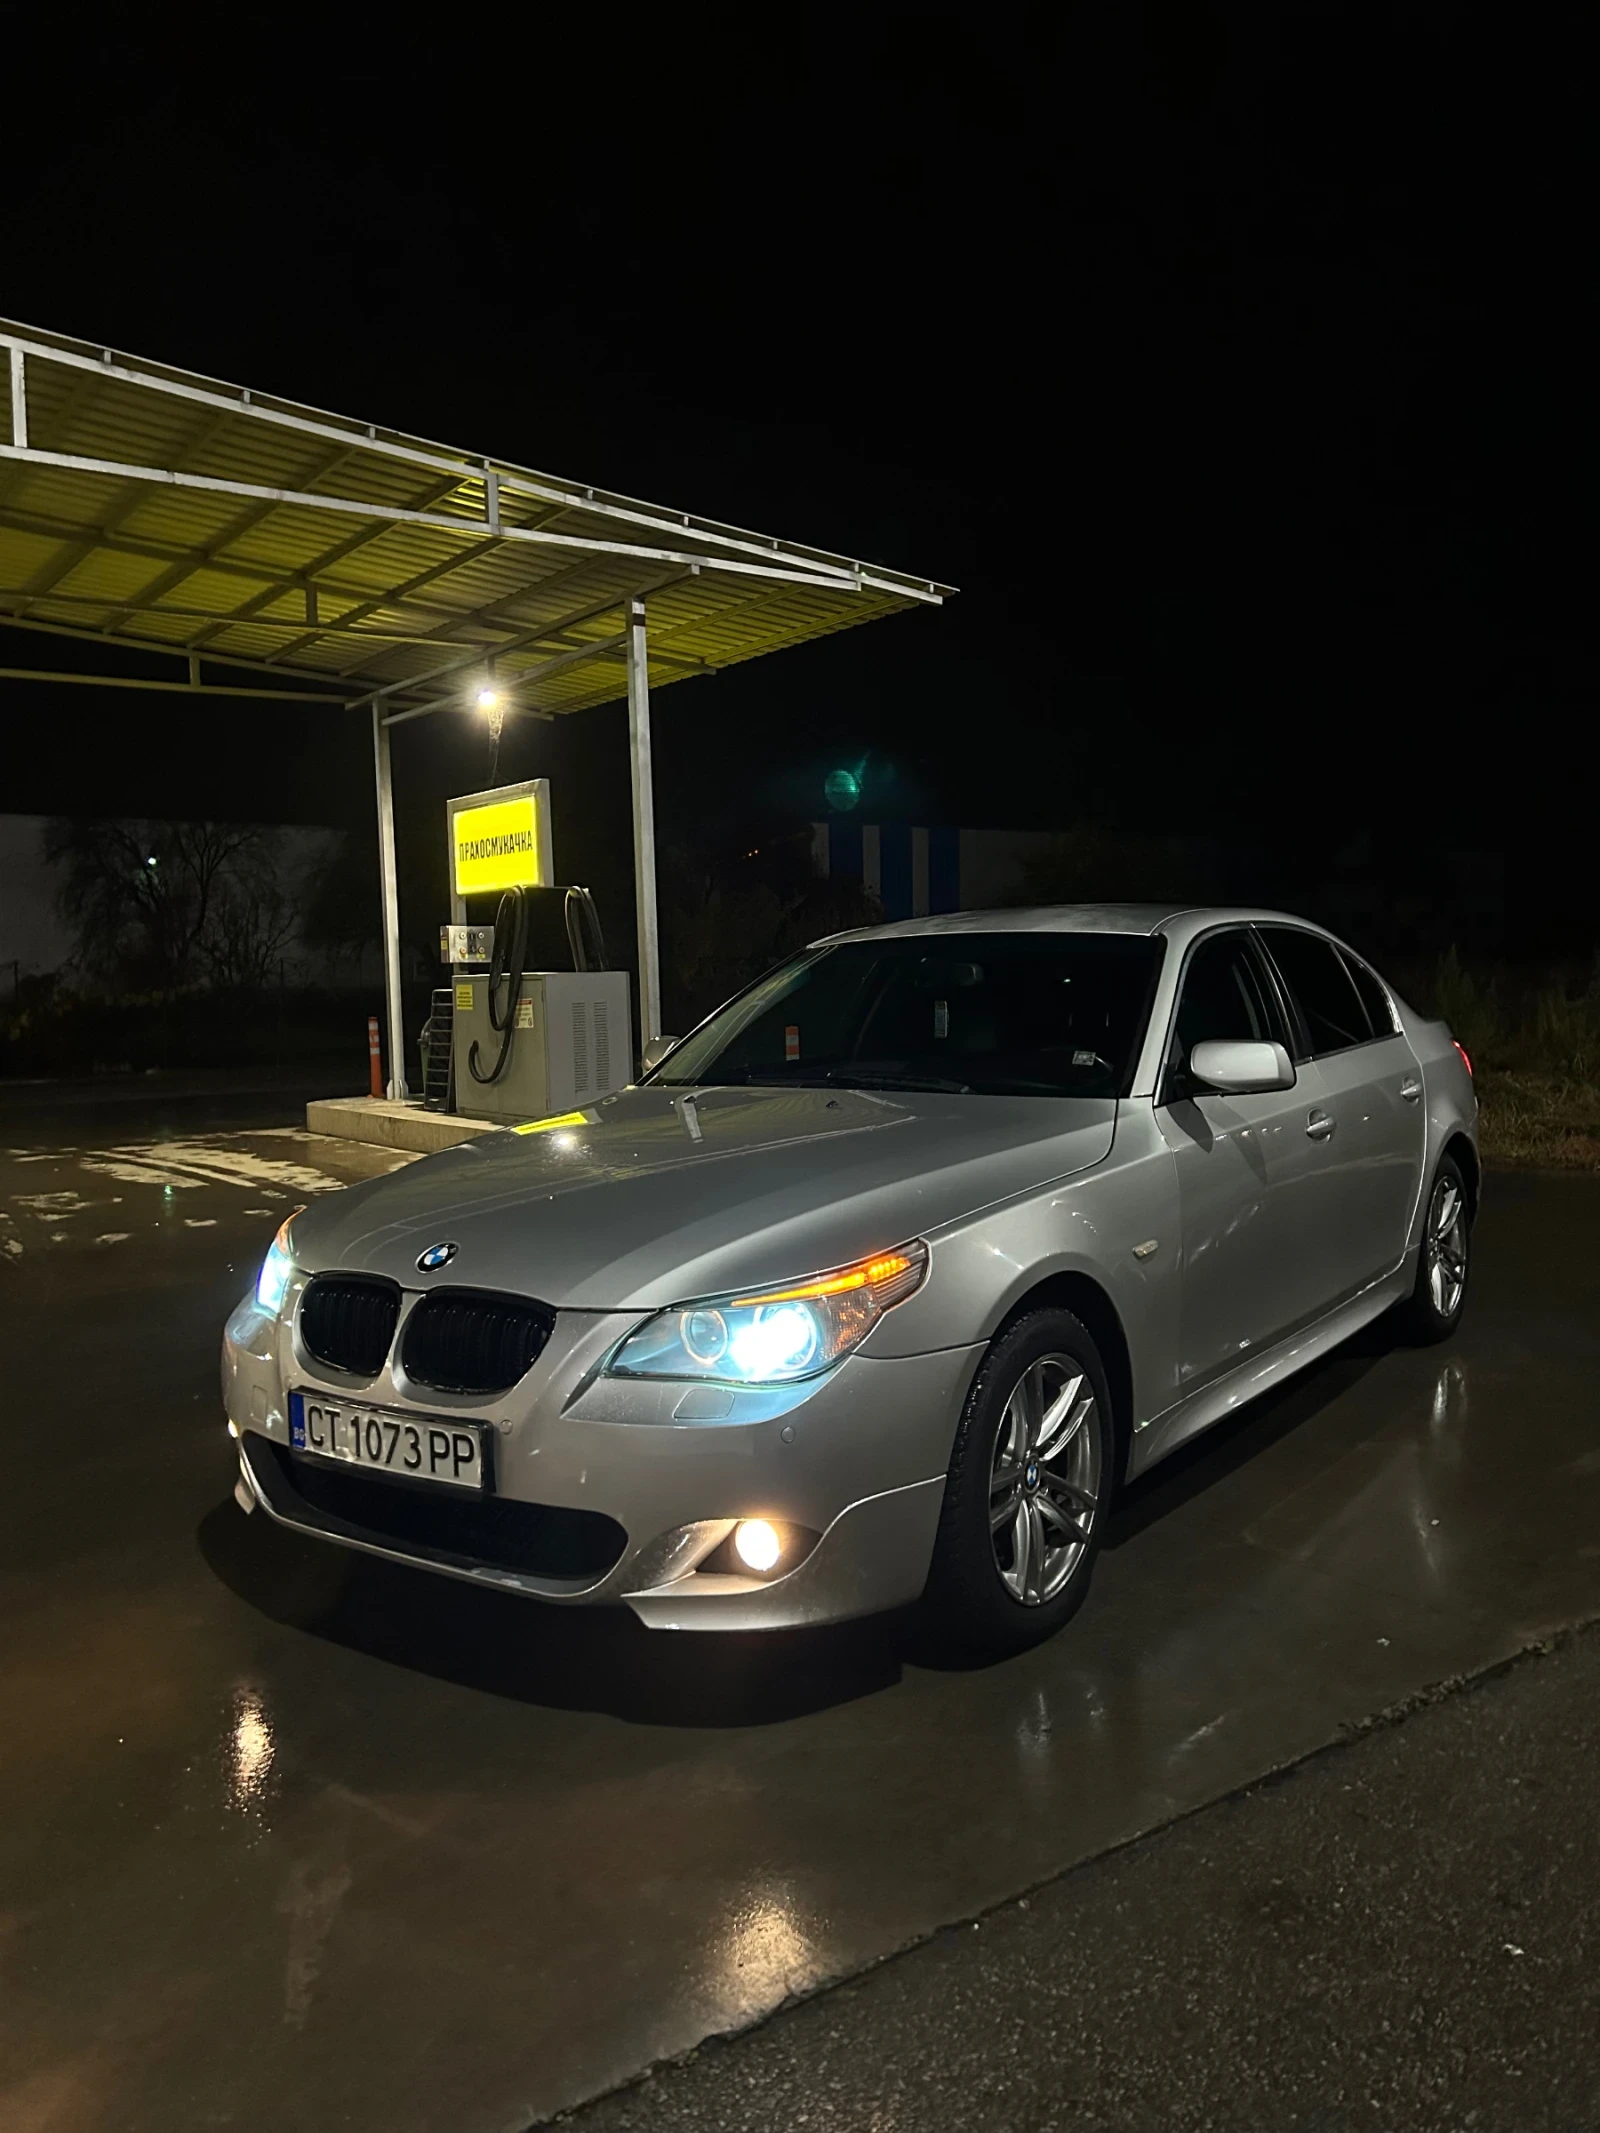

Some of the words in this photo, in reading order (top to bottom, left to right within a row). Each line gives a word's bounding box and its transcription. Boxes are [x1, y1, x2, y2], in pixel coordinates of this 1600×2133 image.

[459, 830, 533, 862] ПРАХОСМУКАЧКА
[293, 1426, 305, 1441] BG
[308, 1405, 341, 1451] CT
[351, 1415, 422, 1469] 1073
[429, 1429, 475, 1477] PP
